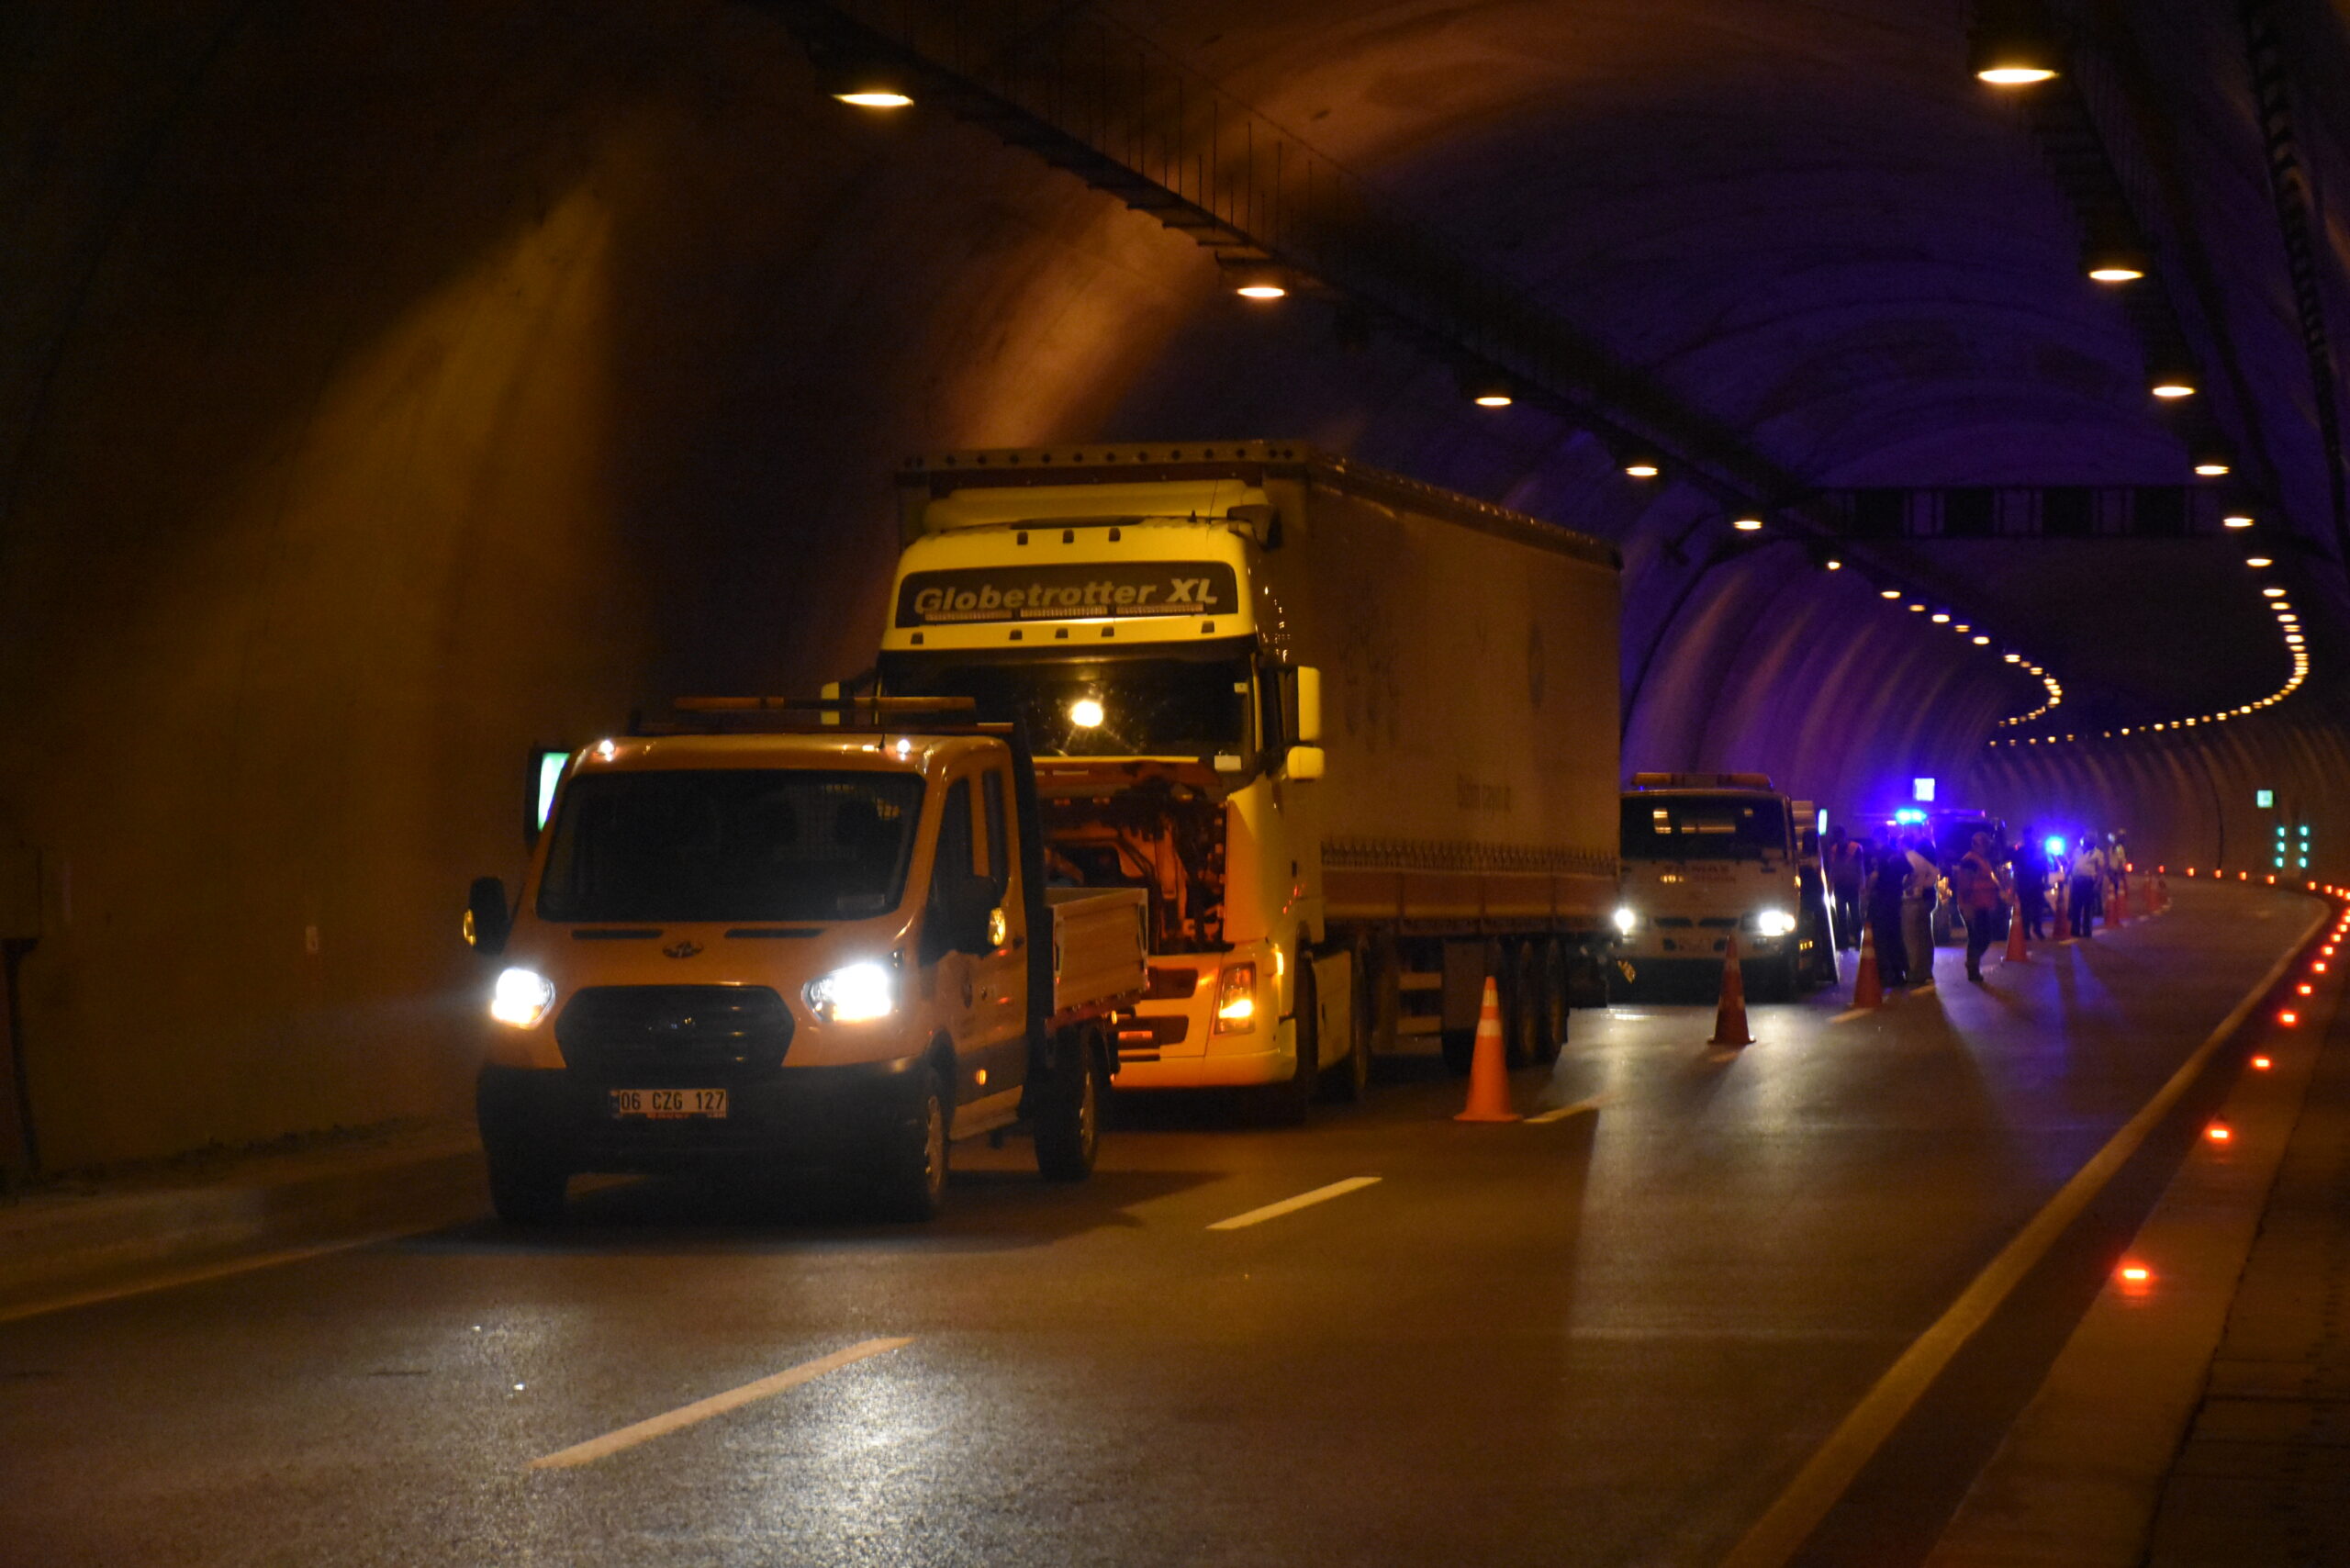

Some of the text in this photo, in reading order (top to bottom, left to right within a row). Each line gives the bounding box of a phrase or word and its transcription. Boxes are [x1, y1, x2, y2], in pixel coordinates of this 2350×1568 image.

[914, 578, 1217, 614] Globetrotter XL
[621, 1091, 724, 1111] 06 CZG 127
